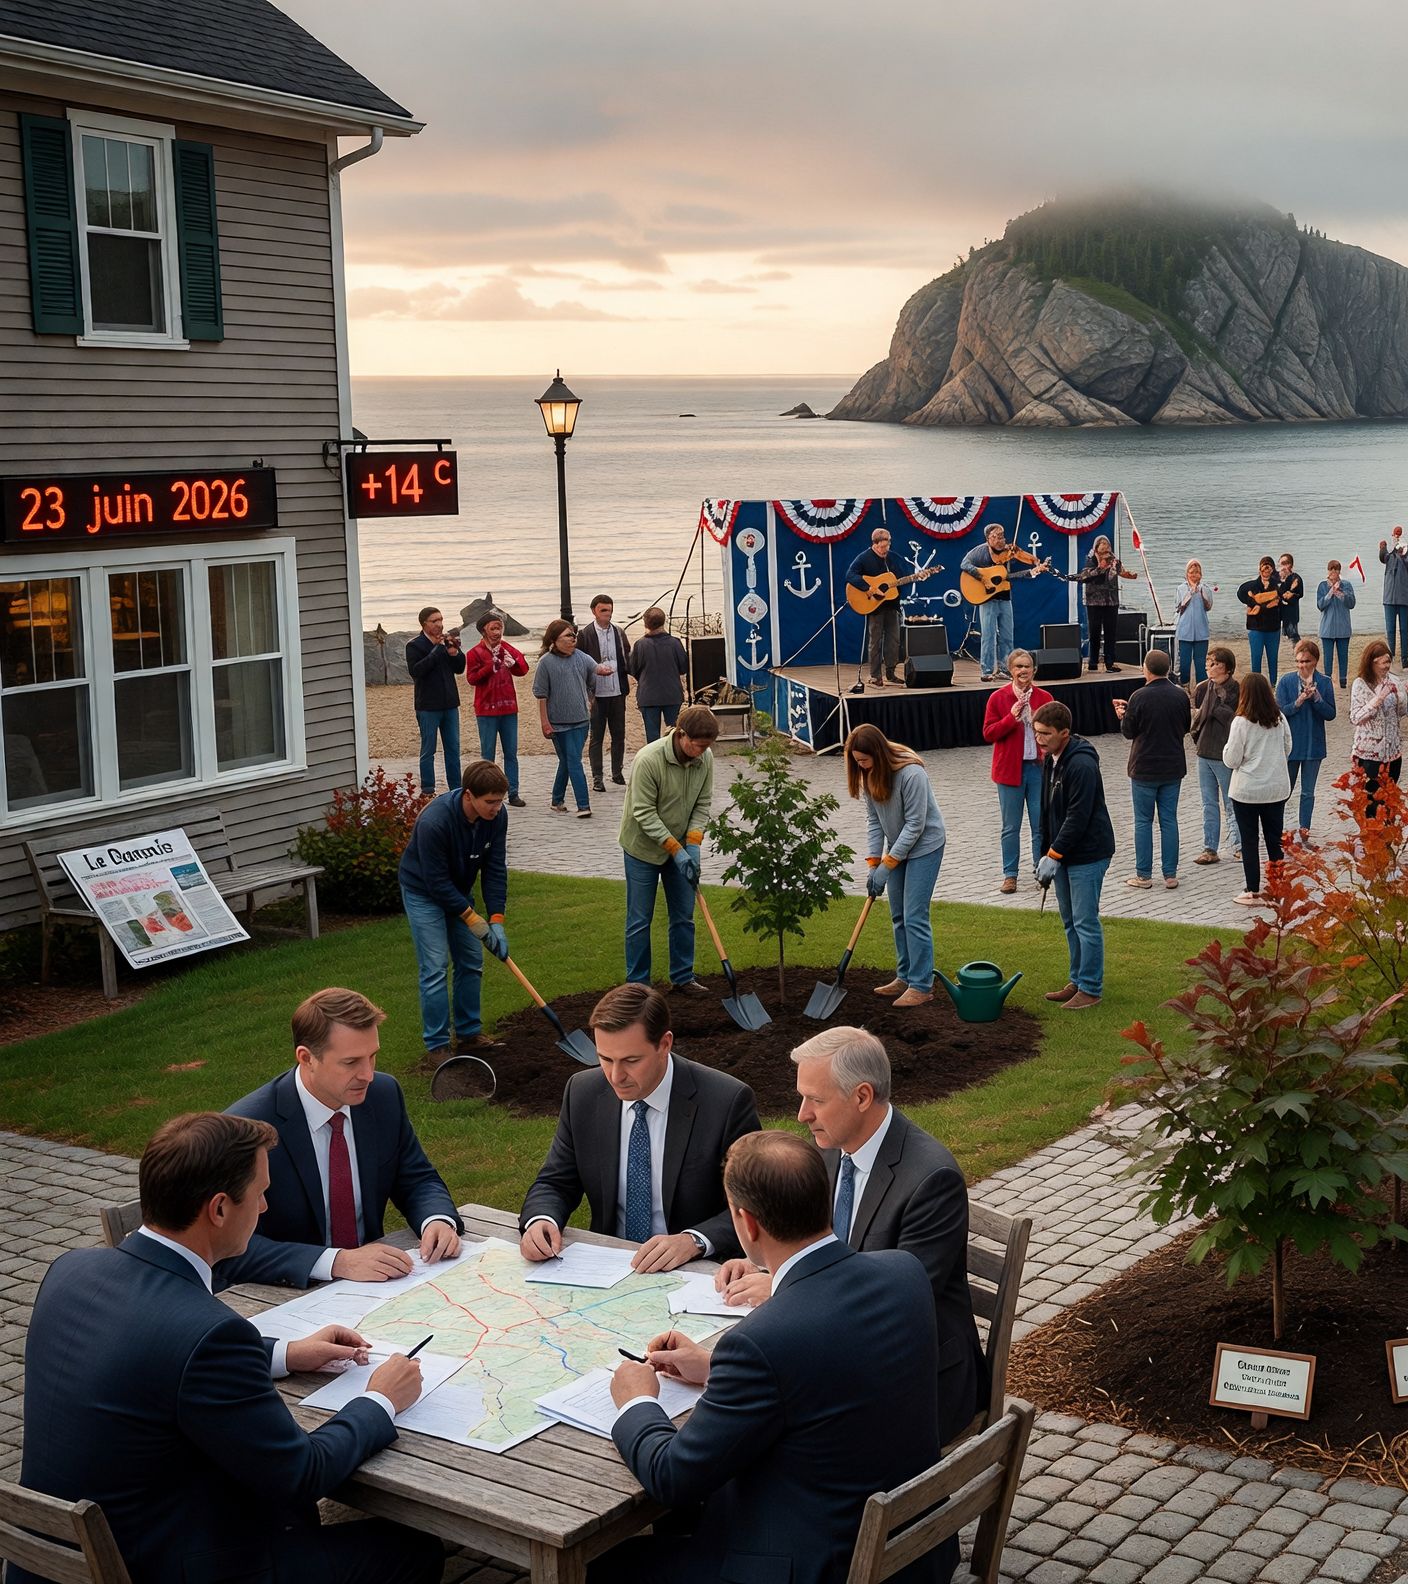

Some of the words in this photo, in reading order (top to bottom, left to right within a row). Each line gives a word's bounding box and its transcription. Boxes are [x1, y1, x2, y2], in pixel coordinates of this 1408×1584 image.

[361, 463, 424, 505] +14
[434, 459, 452, 486] C
[20, 486, 66, 531] 23
[86, 483, 153, 534] juin
[170, 478, 249, 522] 2026
[82, 854, 107, 871] Le
